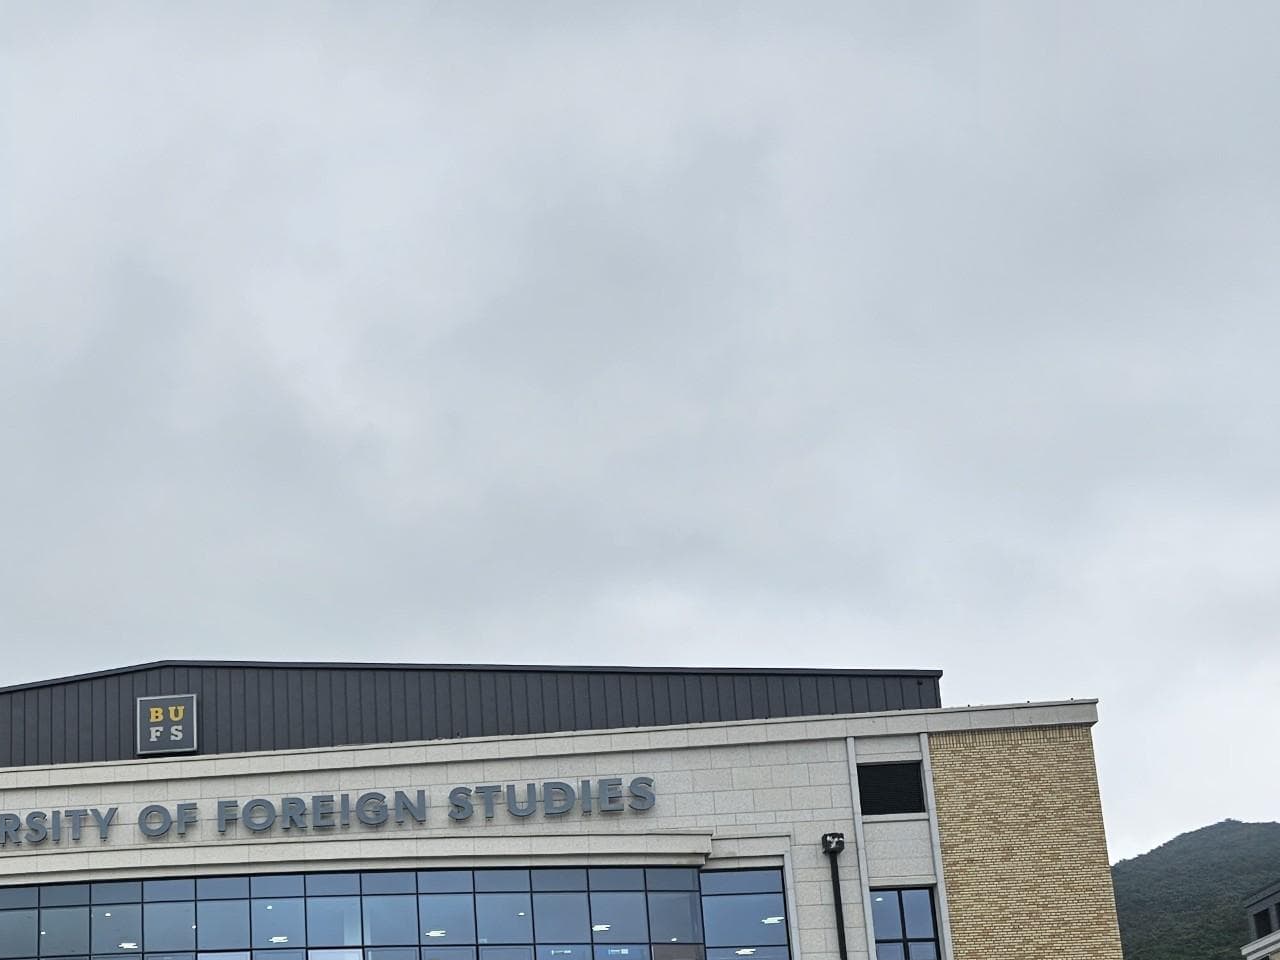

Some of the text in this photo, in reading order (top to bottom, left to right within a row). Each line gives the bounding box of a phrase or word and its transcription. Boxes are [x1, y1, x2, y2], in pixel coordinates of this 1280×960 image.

[150, 705, 185, 722] BU
[150, 725, 183, 742] FS
[138, 803, 198, 837] OF
[217, 790, 426, 832] FOREIGN
[448, 777, 656, 820] STUDIES
